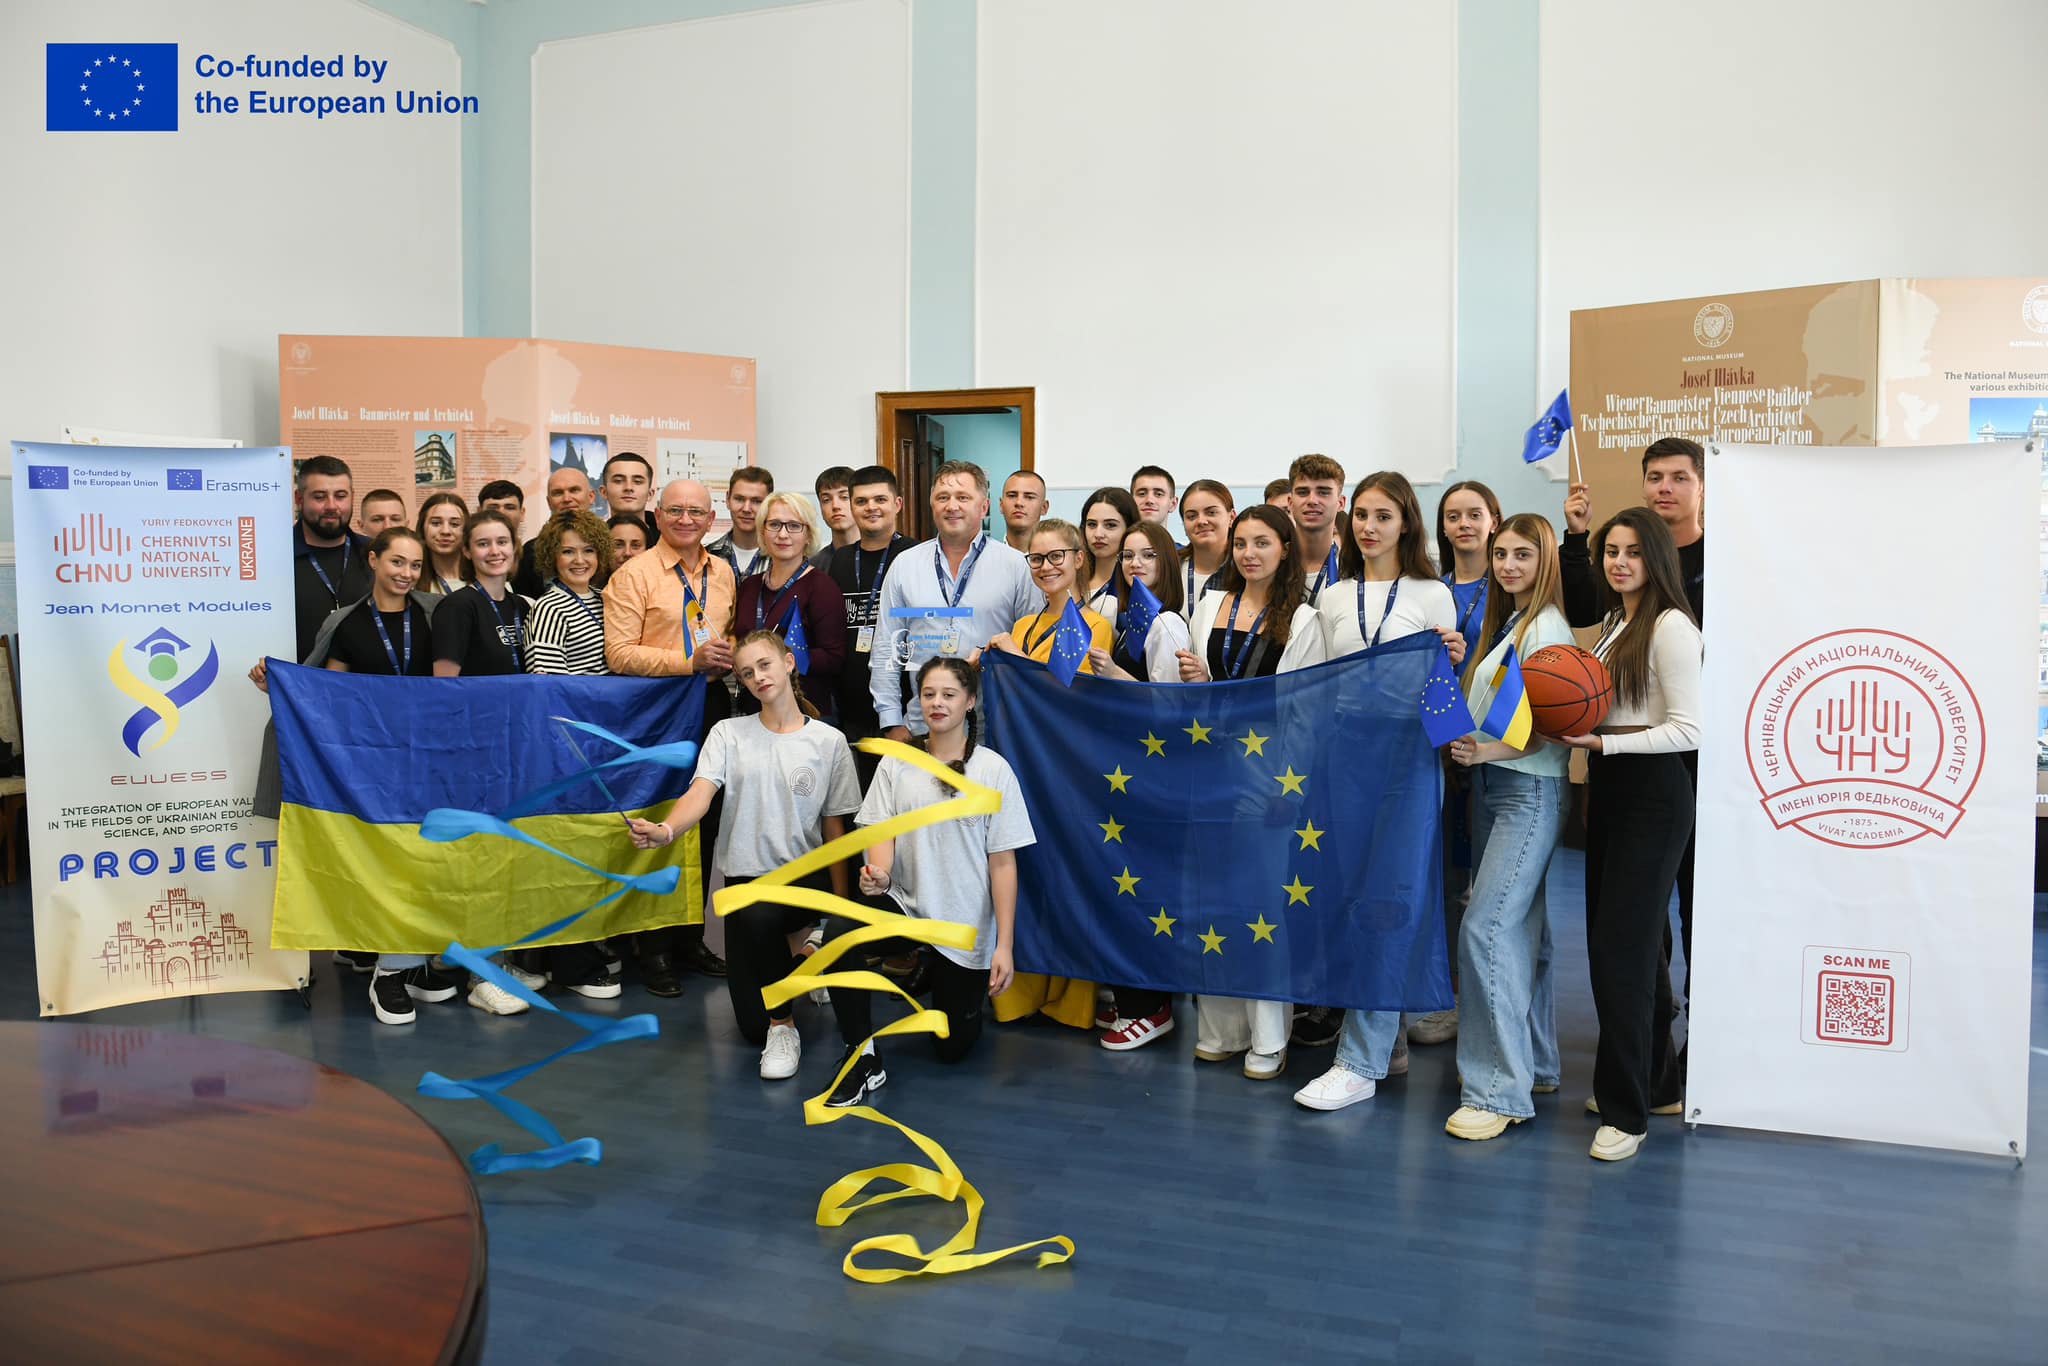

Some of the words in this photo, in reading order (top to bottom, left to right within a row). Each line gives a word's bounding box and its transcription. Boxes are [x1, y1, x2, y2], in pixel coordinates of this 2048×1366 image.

[1680, 368, 1712, 389] Josef
[1944, 372, 1963, 380] The
[1964, 371, 2006, 380] National
[1970, 383, 2006, 391] various
[1606, 394, 1645, 413] Wiener
[1646, 395, 1711, 415] Baumeister
[1714, 386, 1766, 406] Viennese
[1767, 386, 1812, 408] Builder
[1657, 411, 1710, 433] Architekt
[1713, 404, 1747, 425] Czech
[1749, 406, 1803, 428] Architect
[1713, 424, 1769, 444] European
[1771, 427, 1812, 445] Patron
[73, 468, 119, 478] Co-funded
[121, 470, 132, 479] by
[73, 479, 89, 487] the
[91, 479, 131, 489] European
[133, 479, 159, 487] Union
[206, 480, 281, 492] Erasmus+
[142, 519, 171, 527] YURIY
[174, 519, 233, 527] FEDKOVYCH
[141, 535, 232, 548] CHERNIVTSI
[239, 518, 255, 579] UKRAINE
[141, 551, 220, 563] NATIONAL
[55, 563, 132, 584] CHNU
[142, 565, 231, 579] UNIVERSITY
[44, 603, 94, 615] Jean
[101, 601, 181, 614] Monnet
[188, 600, 272, 613] Modules
[1761, 666, 1806, 777] ЧЕРНІВЕЦЬКИЙ
[1804, 644, 1940, 683] НАЦІОНАЛЬНИЙ
[1935, 681, 1968, 785] УНІВЕРСИТЕТ
[61, 803, 142, 817] INTEGRATION
[146, 802, 162, 812] OF
[166, 799, 228, 811] EUROPEAN
[232, 797, 255, 806] VAL
[1777, 794, 1815, 815] ІМЕНІ
[1817, 791, 1850, 804] ЮРІЯ
[1854, 791, 1945, 823] ФЕДЬКОВИЧА
[48, 822, 59, 831] IN
[65, 819, 87, 829] THE
[92, 816, 133, 827] FIELDS
[137, 815, 153, 825] OF
[157, 812, 217, 824] UKRAINIAN
[221, 810, 255, 819] EDUC
[104, 828, 159, 839] SCIENCE,
[162, 826, 186, 836] AND
[191, 822, 239, 834] SPORTS
[1817, 822, 1847, 838] VIVAT
[1849, 826, 1905, 840] ACADEMIA
[59, 840, 278, 882] PROJECT
[1823, 954, 1865, 968] SCAN
[1868, 958, 1891, 970] ME
